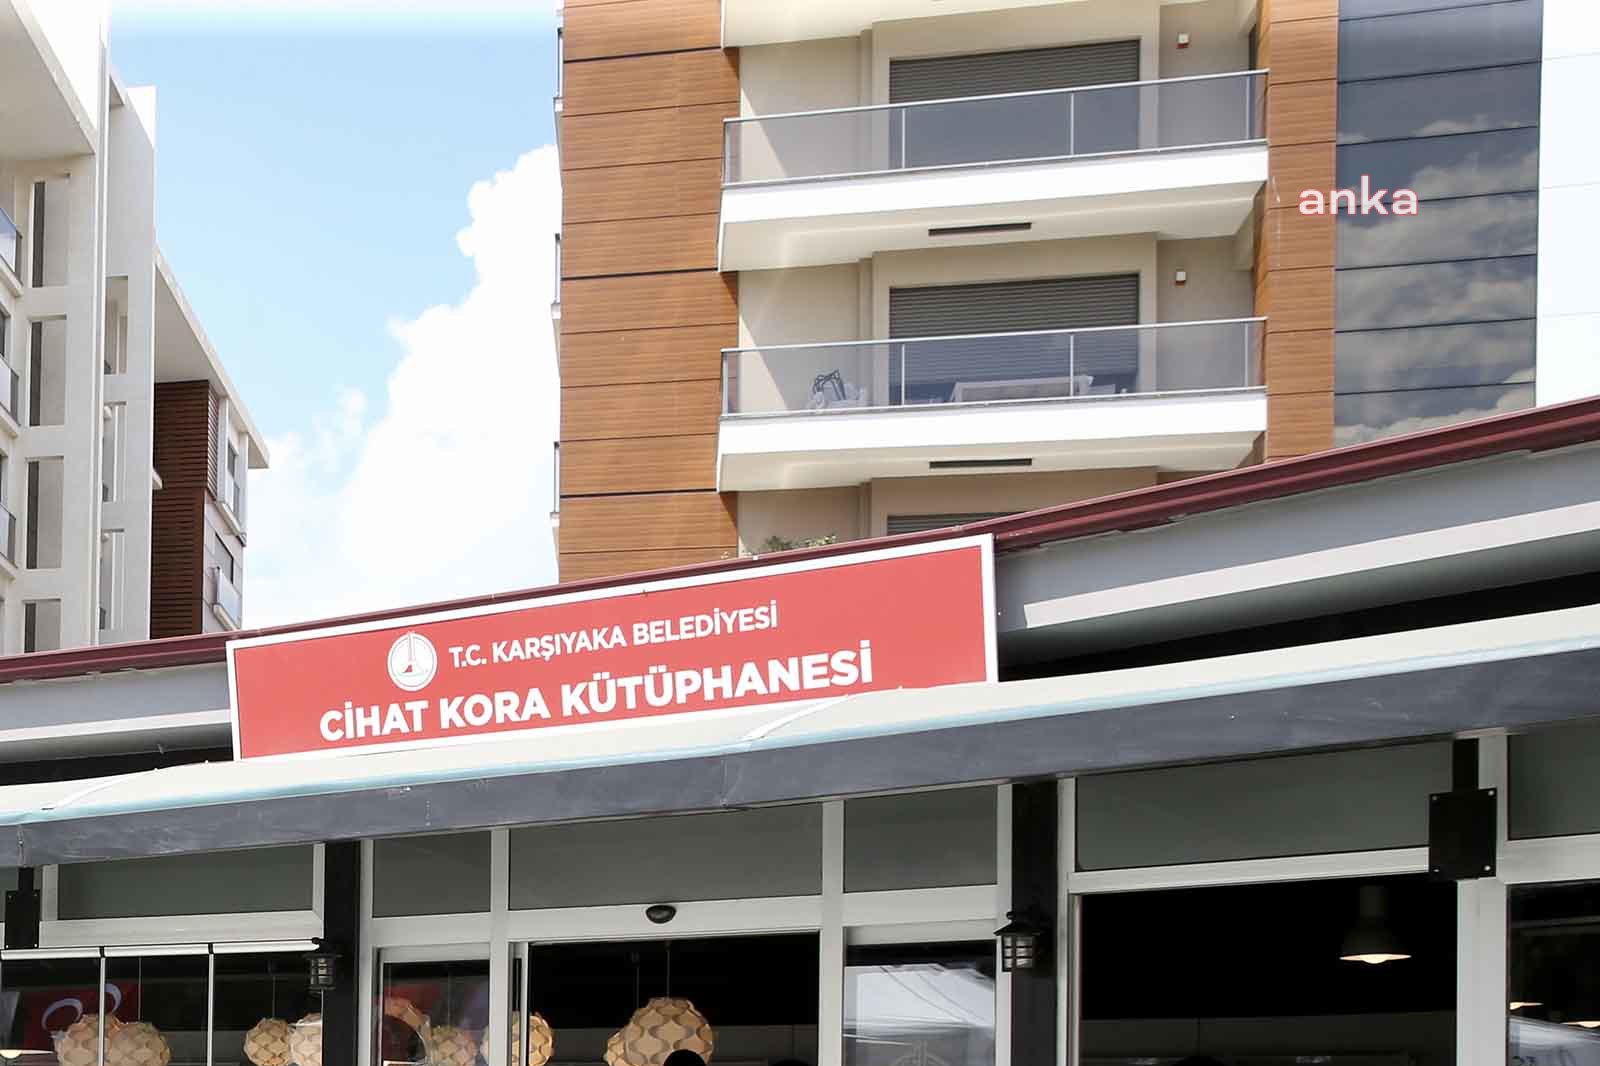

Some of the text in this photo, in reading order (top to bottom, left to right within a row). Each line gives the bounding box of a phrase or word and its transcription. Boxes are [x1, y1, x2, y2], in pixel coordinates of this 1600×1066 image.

[448, 600, 778, 668] T.C. KARŞIYAKA BELEDİYESİ
[319, 639, 873, 742] CİHAT KORA KÜTÜPHANESİ
